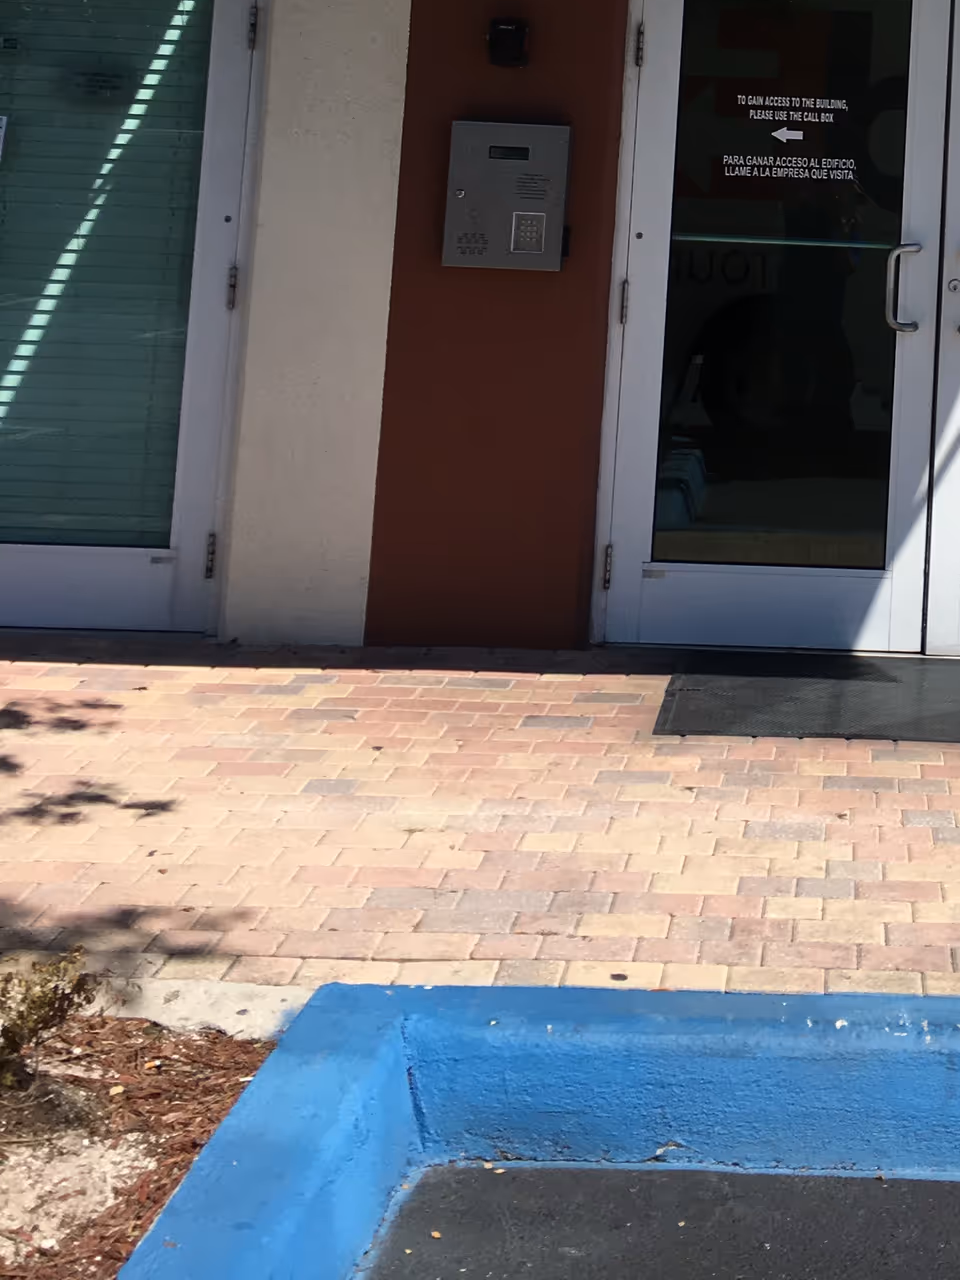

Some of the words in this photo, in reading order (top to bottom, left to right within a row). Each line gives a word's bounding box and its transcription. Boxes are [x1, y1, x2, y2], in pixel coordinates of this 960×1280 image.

[737, 95, 746, 105] TO
[747, 96, 764, 106] GAIN
[764, 96, 790, 107] ACCESS
[791, 97, 801, 107] TO
[801, 98, 815, 108] THE
[815, 98, 848, 111] BUILDING,
[749, 110, 773, 120] PLEASE
[774, 110, 788, 121] USE
[789, 111, 802, 121] THE
[803, 112, 819, 122] CALL
[820, 112, 834, 123] BOX
[723, 155, 745, 165] PARA
[746, 156, 774, 166] GANAR
[775, 157, 808, 167] ACCESO
[809, 158, 820, 168] AL
[821, 158, 857, 170] EDIFICIO,
[725, 166, 751, 177] LLAME
[752, 167, 759, 177] A
[760, 167, 771, 177] LA
[772, 167, 809, 178] EMPRESA
[811, 169, 829, 180] QUE
[829, 170, 854, 180] VISITA
